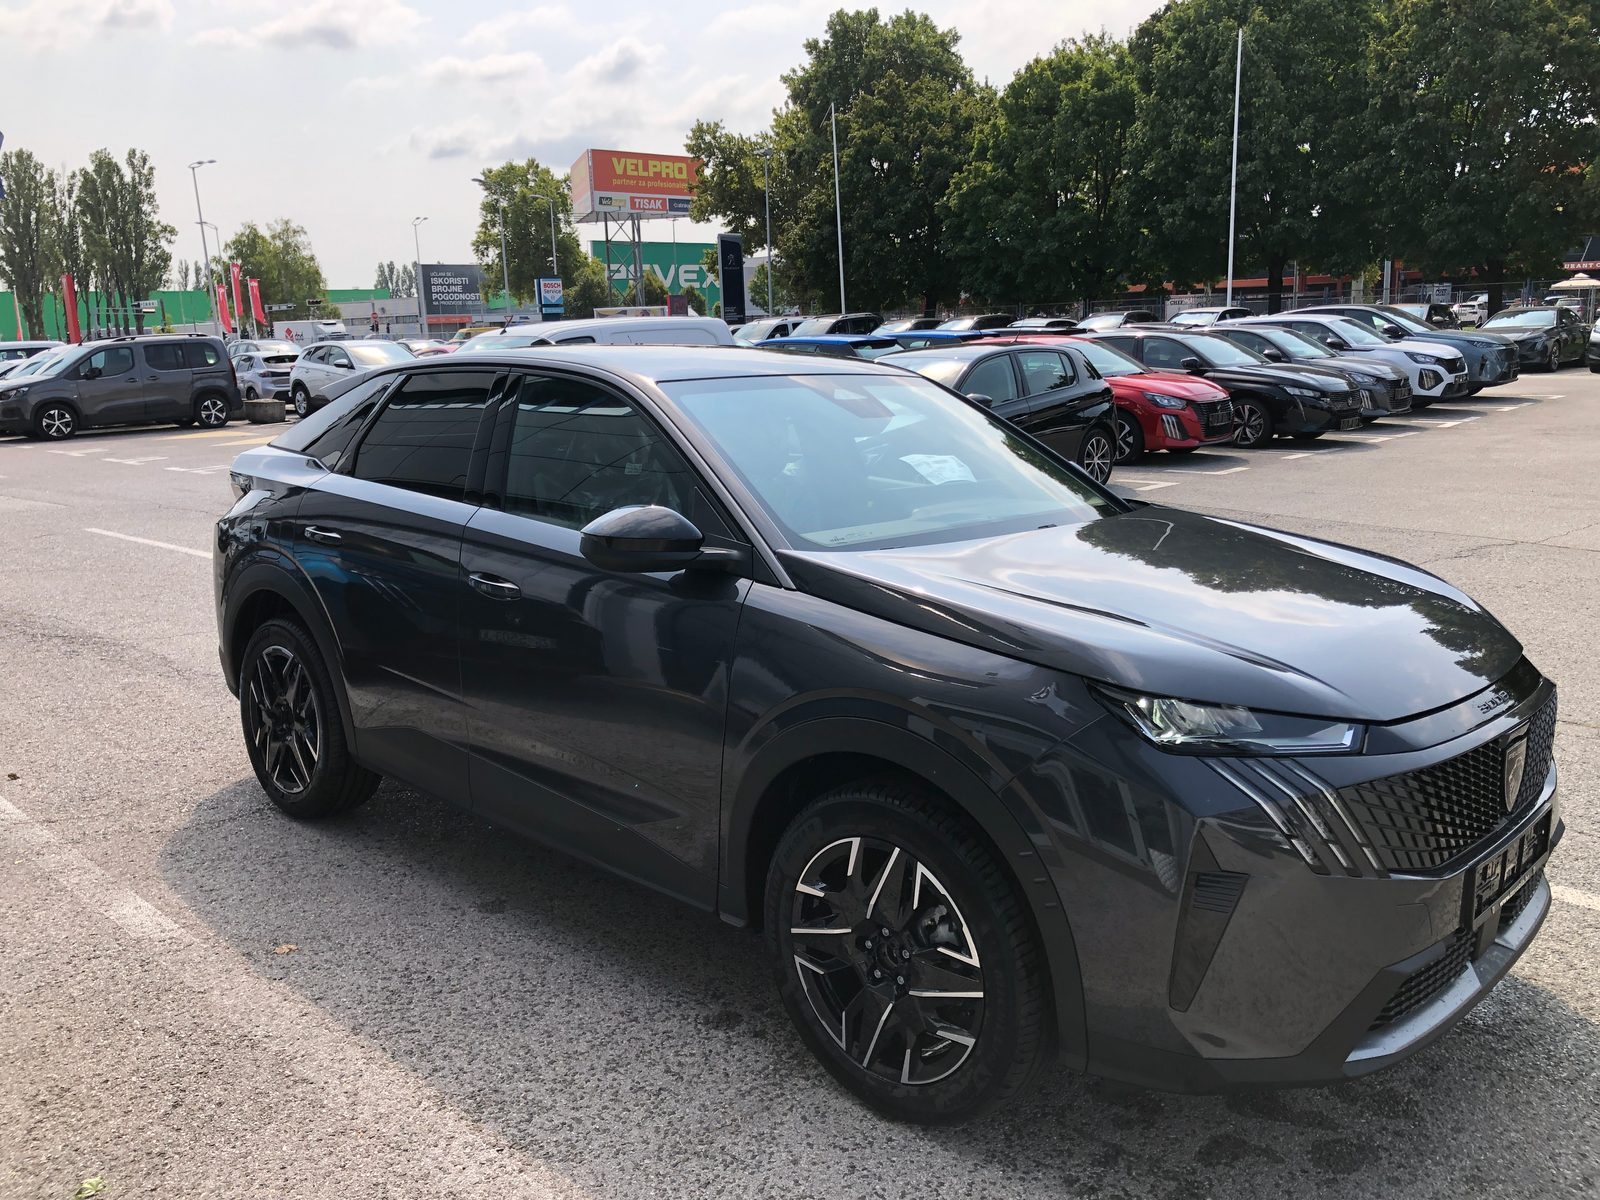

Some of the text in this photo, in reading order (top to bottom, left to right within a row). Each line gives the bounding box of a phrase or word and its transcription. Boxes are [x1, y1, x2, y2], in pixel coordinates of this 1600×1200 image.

[612, 157, 688, 179] VELPRO
[612, 178, 636, 186] partner
[634, 198, 663, 209] TISAK
[430, 277, 469, 285] ISKORISTI
[431, 285, 463, 293] BROJNE
[432, 293, 481, 301] POGODNOST
[1477, 690, 1509, 714] 3008
